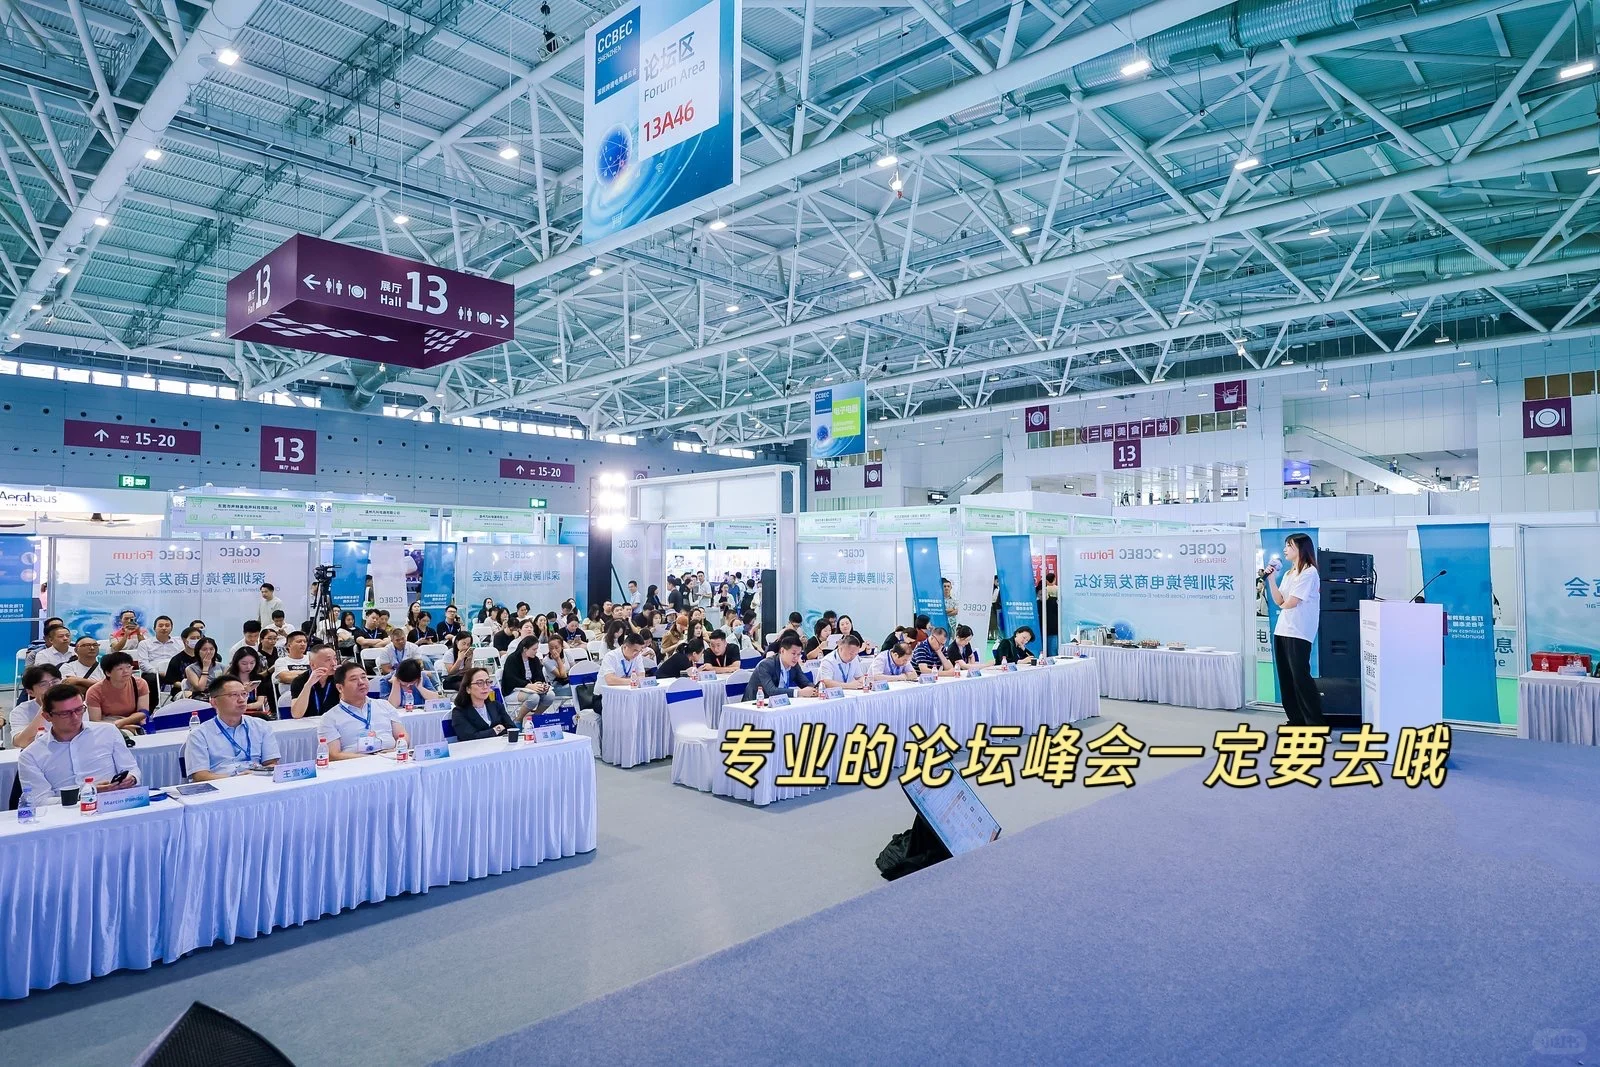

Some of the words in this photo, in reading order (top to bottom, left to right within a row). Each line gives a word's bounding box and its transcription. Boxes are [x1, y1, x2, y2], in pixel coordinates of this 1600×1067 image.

[597, 19, 633, 53] CCBEC
[597, 44, 622, 64] SHENZHEN
[644, 31, 695, 82] 论坛区
[644, 75, 677, 102] Forum
[680, 58, 706, 83] Area
[643, 99, 695, 142] 13A46
[256, 264, 270, 309] 13
[380, 280, 402, 294] 展厅
[406, 271, 447, 315] 13
[380, 294, 401, 308] Hall
[1091, 422, 1168, 439] 三楼美食广场
[135, 432, 176, 448] 15-20
[274, 437, 305, 463] 13
[1118, 446, 1136, 462] 13
[538, 466, 561, 478] 15-20
[0, 490, 57, 503] Aerahaus
[103, 799, 124, 807] Marcin
